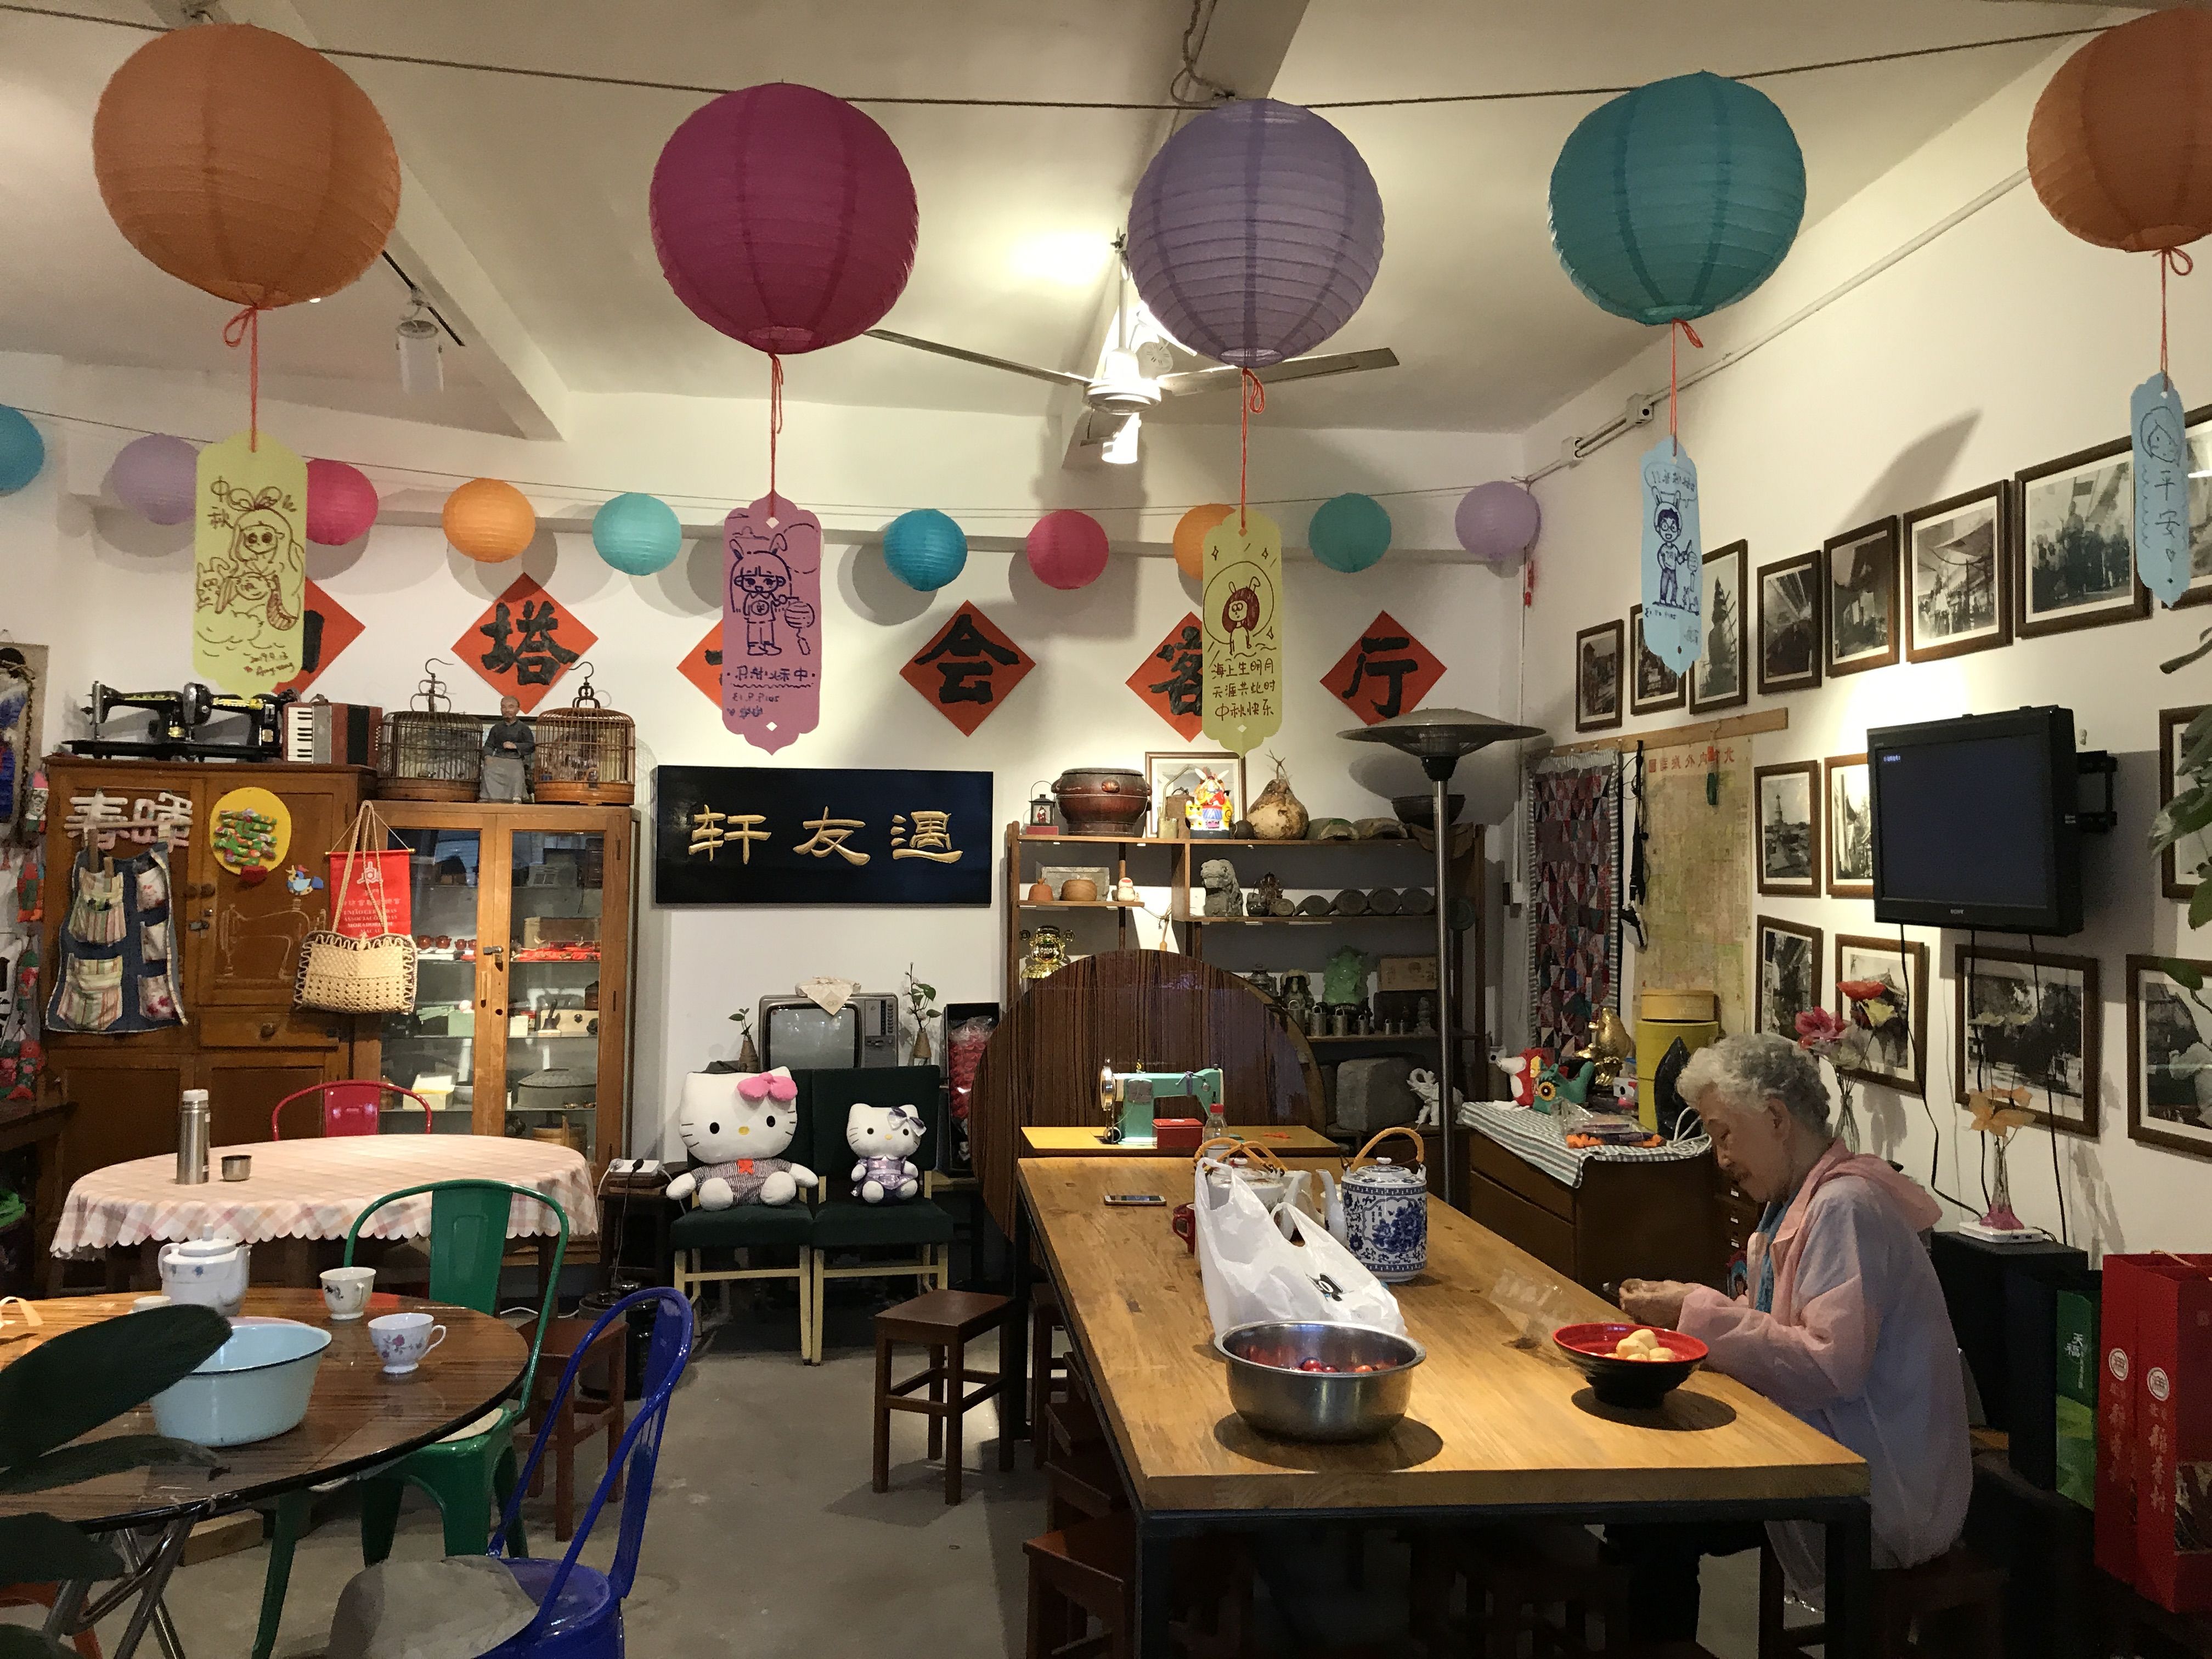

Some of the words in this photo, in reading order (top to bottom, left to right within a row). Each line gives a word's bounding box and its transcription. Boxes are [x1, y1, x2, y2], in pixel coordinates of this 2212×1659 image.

[2154, 470, 2181, 539] 平安
[479, 601, 579, 686] 塔
[915, 614, 1022, 704] 会
[1211, 658, 1273, 679] 海上生明月
[1342, 636, 1418, 718] 厅
[1212, 680, 1275, 698] 天涯共此时
[1215, 699, 1274, 721] 中秋快乐
